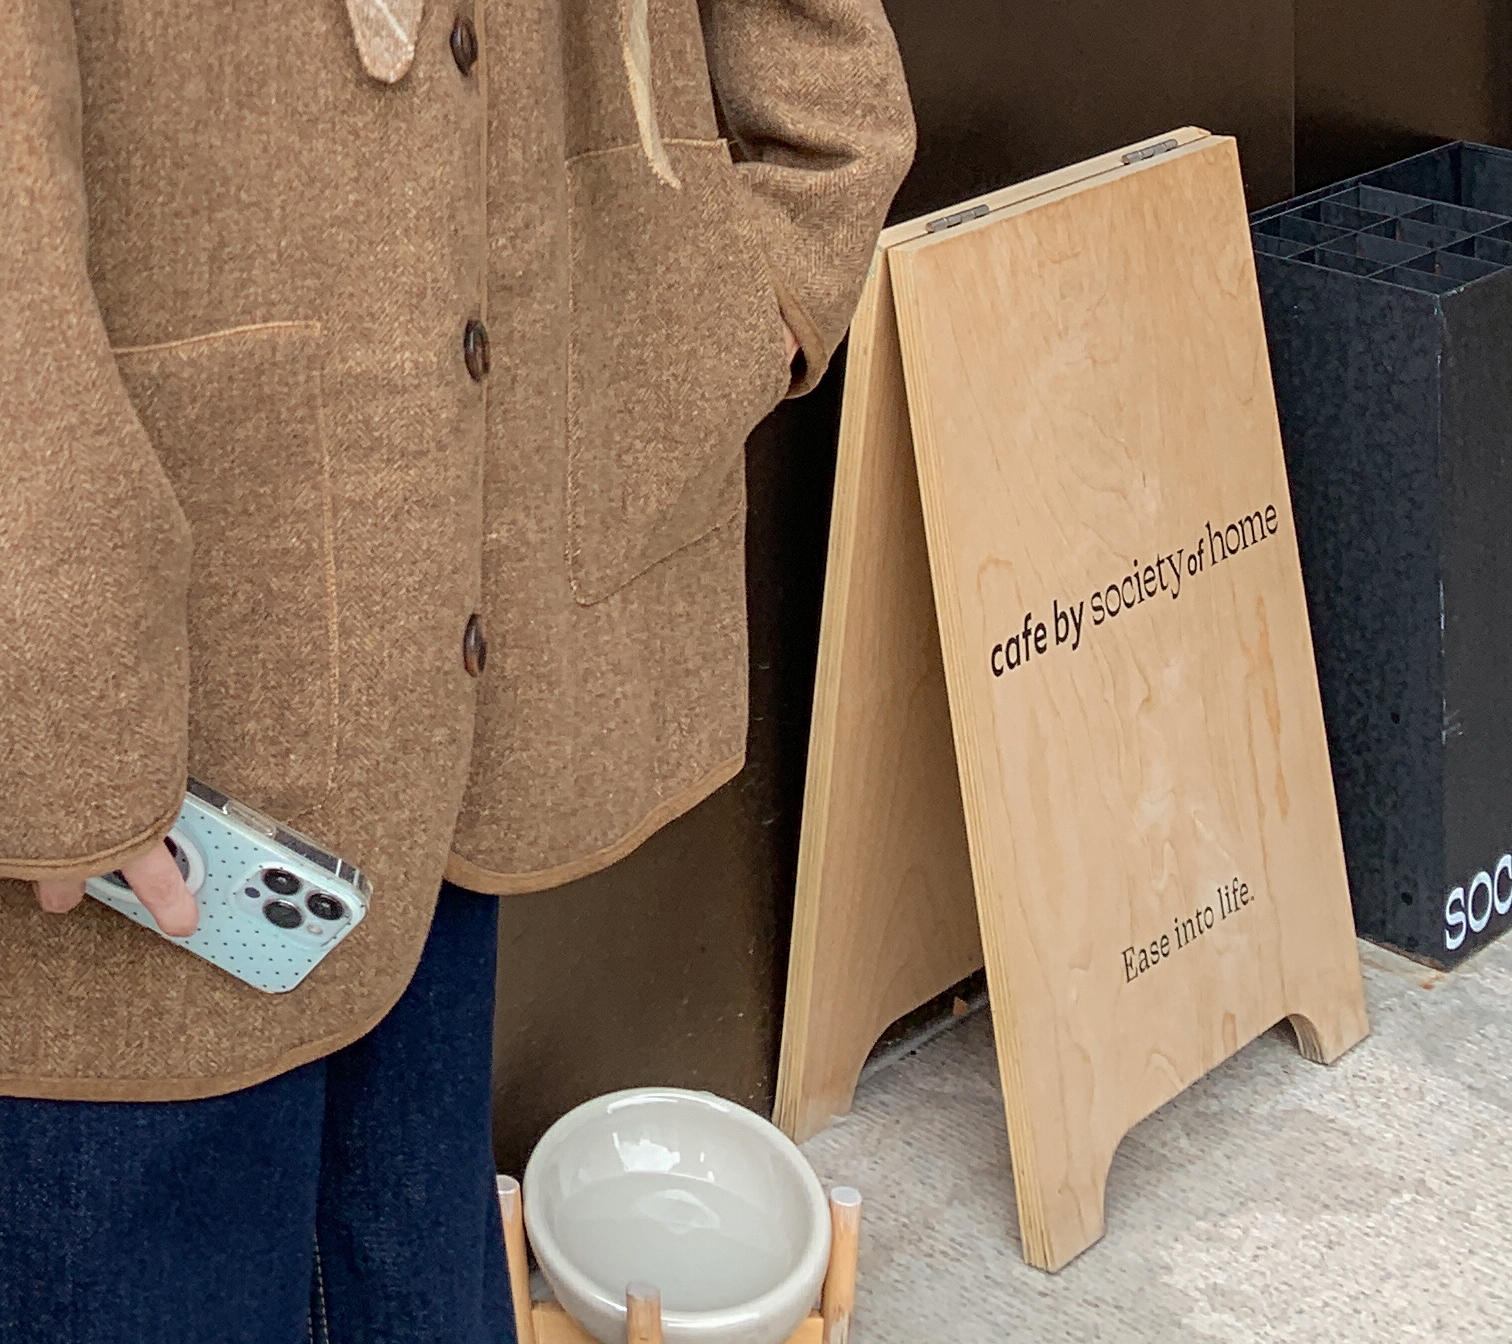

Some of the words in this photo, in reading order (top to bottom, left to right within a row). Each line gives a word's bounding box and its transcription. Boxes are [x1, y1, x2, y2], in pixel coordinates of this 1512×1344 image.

[991, 612, 1047, 677] cafe
[1053, 599, 1084, 651] by
[1090, 548, 1184, 626] society
[1188, 538, 1204, 576] of
[1205, 504, 1279, 567] home
[1121, 934, 1170, 983] Ease
[1174, 906, 1214, 950] into
[1217, 876, 1254, 920] life.
